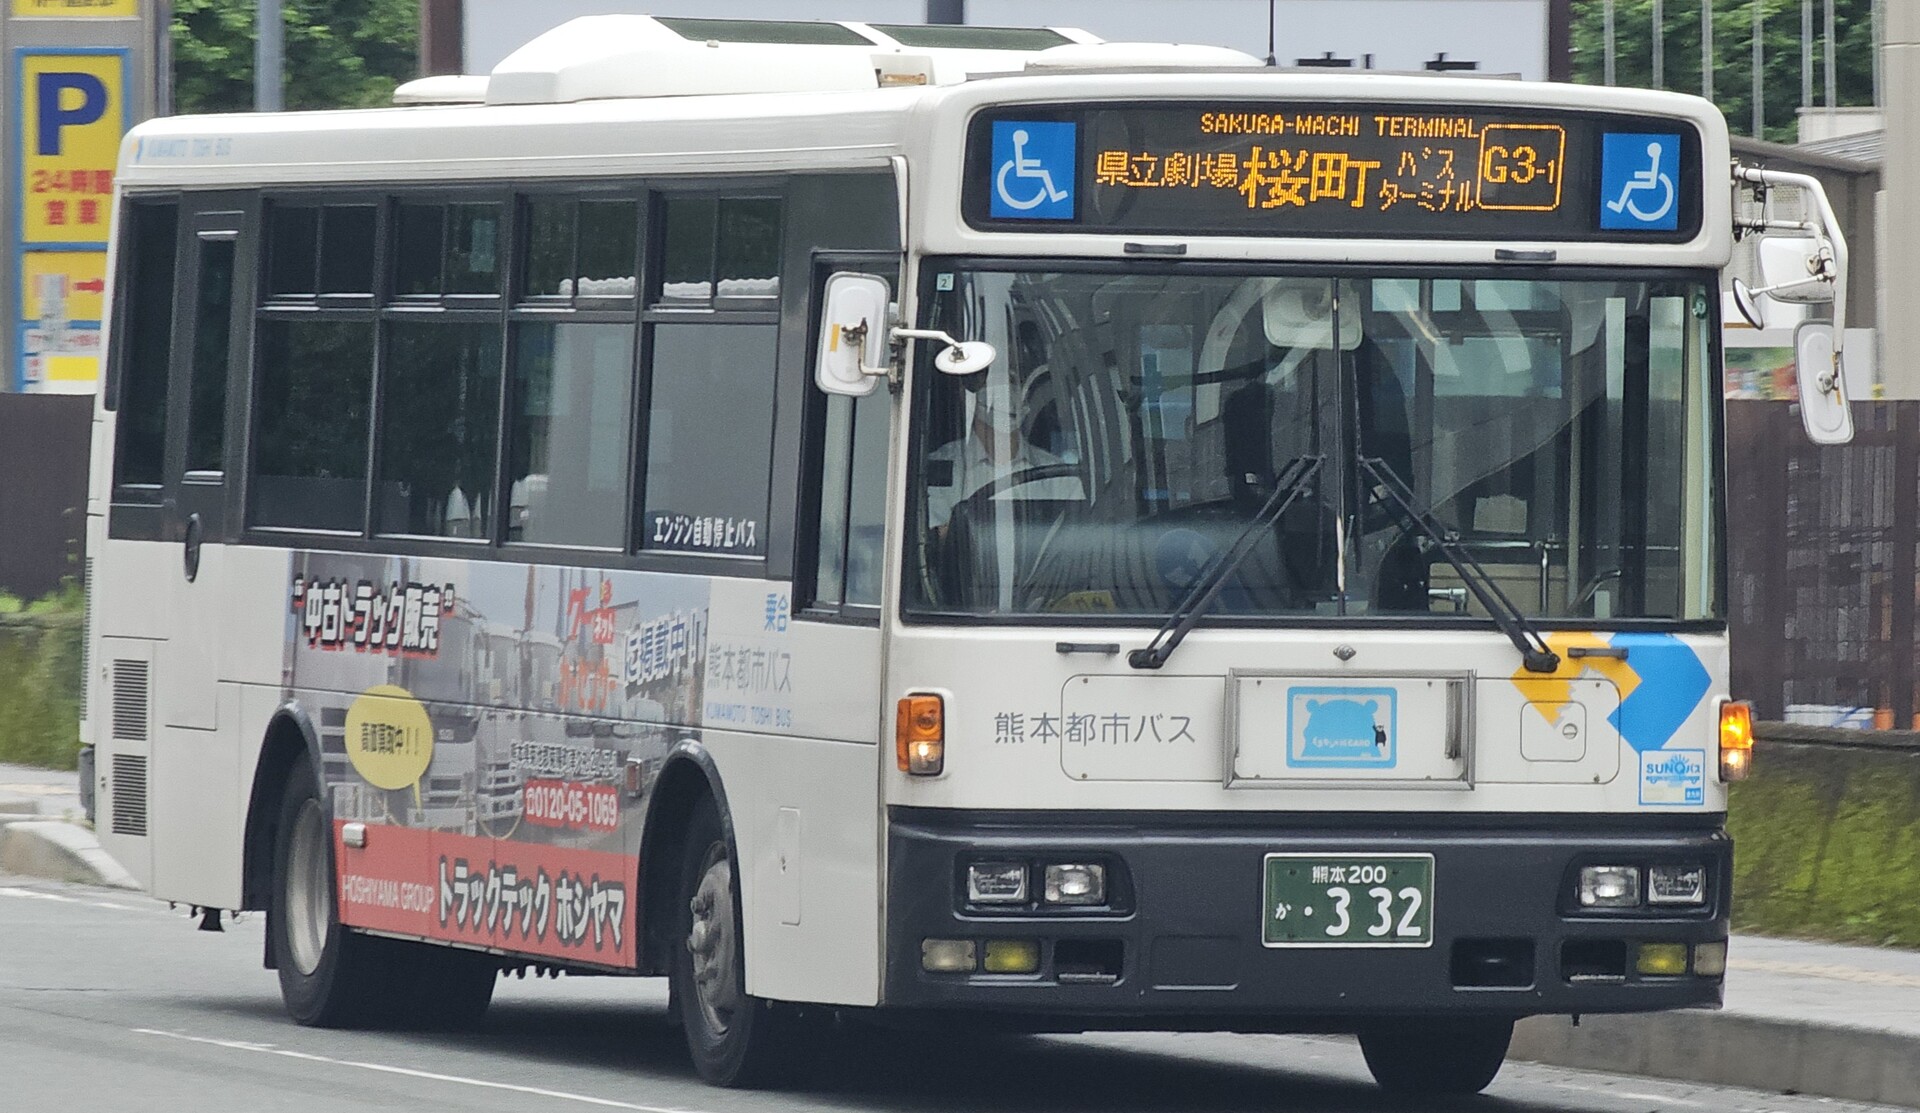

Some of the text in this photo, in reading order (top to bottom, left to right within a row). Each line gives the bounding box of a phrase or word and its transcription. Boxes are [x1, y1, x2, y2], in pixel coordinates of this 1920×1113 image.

[37, 72, 108, 156] P
[1201, 113, 1480, 139] SAKURA-MACHI TERMINAL
[1096, 146, 1381, 209] 県立劇場 桜町
[1398, 147, 1455, 180] バス
[1483, 145, 1555, 184] G3-1
[1379, 178, 1475, 212] ターミナル
[653, 515, 757, 548] エンジン自動停止バス
[705, 645, 792, 694] 熊本都市バス
[993, 711, 1196, 747] 熊本都市バス
[400, 881, 436, 914] GROUP
[438, 858, 626, 945] トラックテック ホシヤマ
